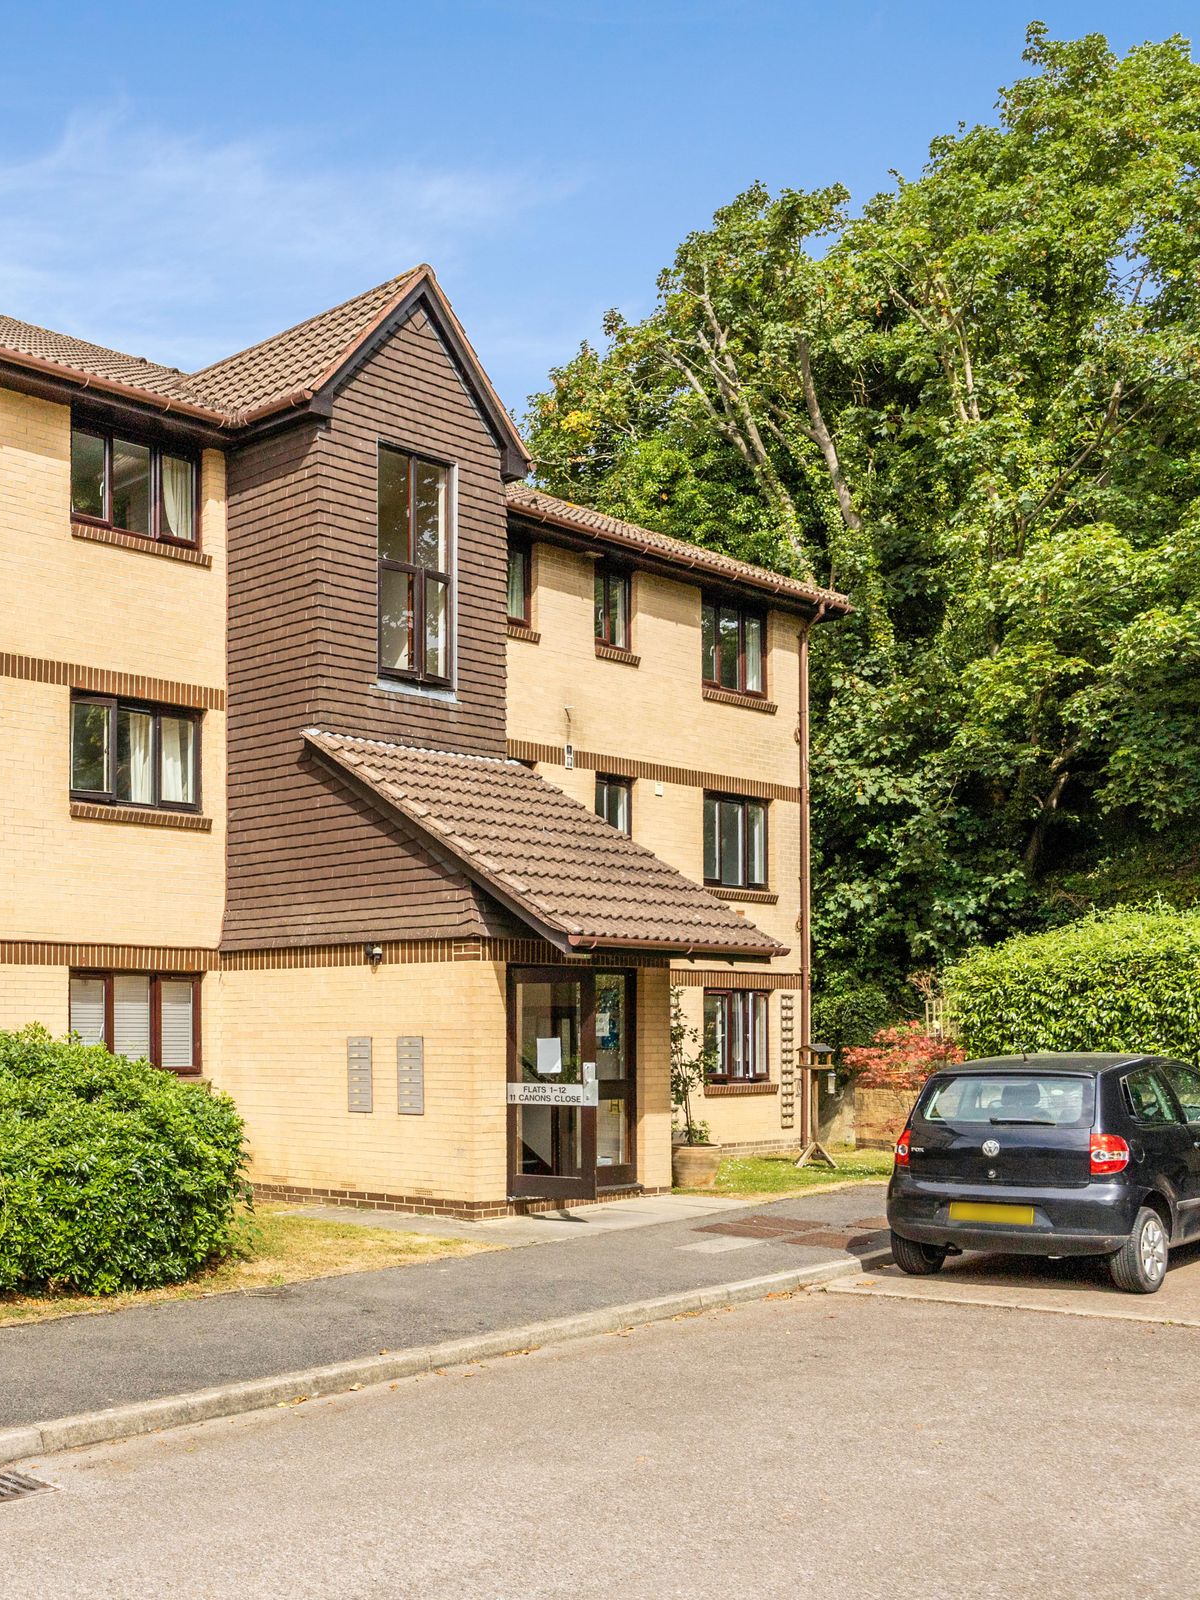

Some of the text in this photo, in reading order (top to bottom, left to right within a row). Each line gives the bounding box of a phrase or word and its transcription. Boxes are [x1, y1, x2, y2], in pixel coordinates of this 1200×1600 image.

[523, 1086, 567, 1094] FLATS 1-12
[518, 1094, 552, 1102] CANONS
[554, 1095, 581, 1103] CLOSE
